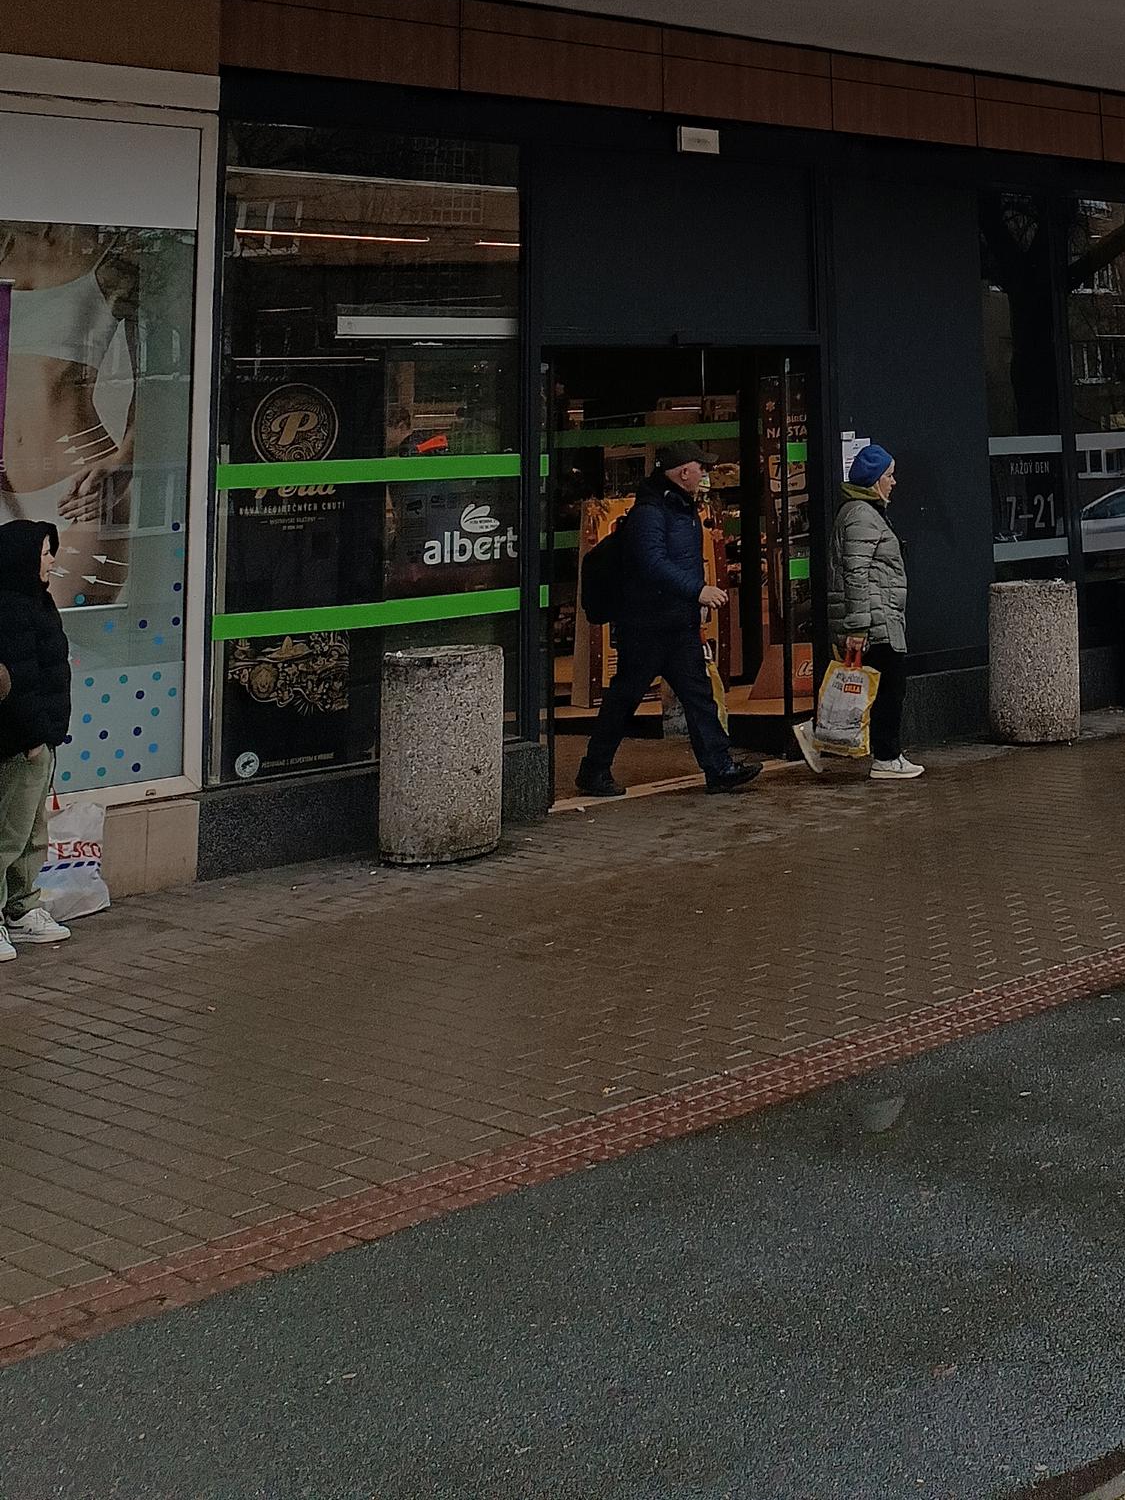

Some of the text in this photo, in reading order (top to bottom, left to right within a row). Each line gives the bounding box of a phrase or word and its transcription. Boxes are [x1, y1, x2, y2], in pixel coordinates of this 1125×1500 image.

[1035, 460, 1050, 474] DEN
[423, 526, 519, 566] albert
[49, 841, 102, 860] ESCO
